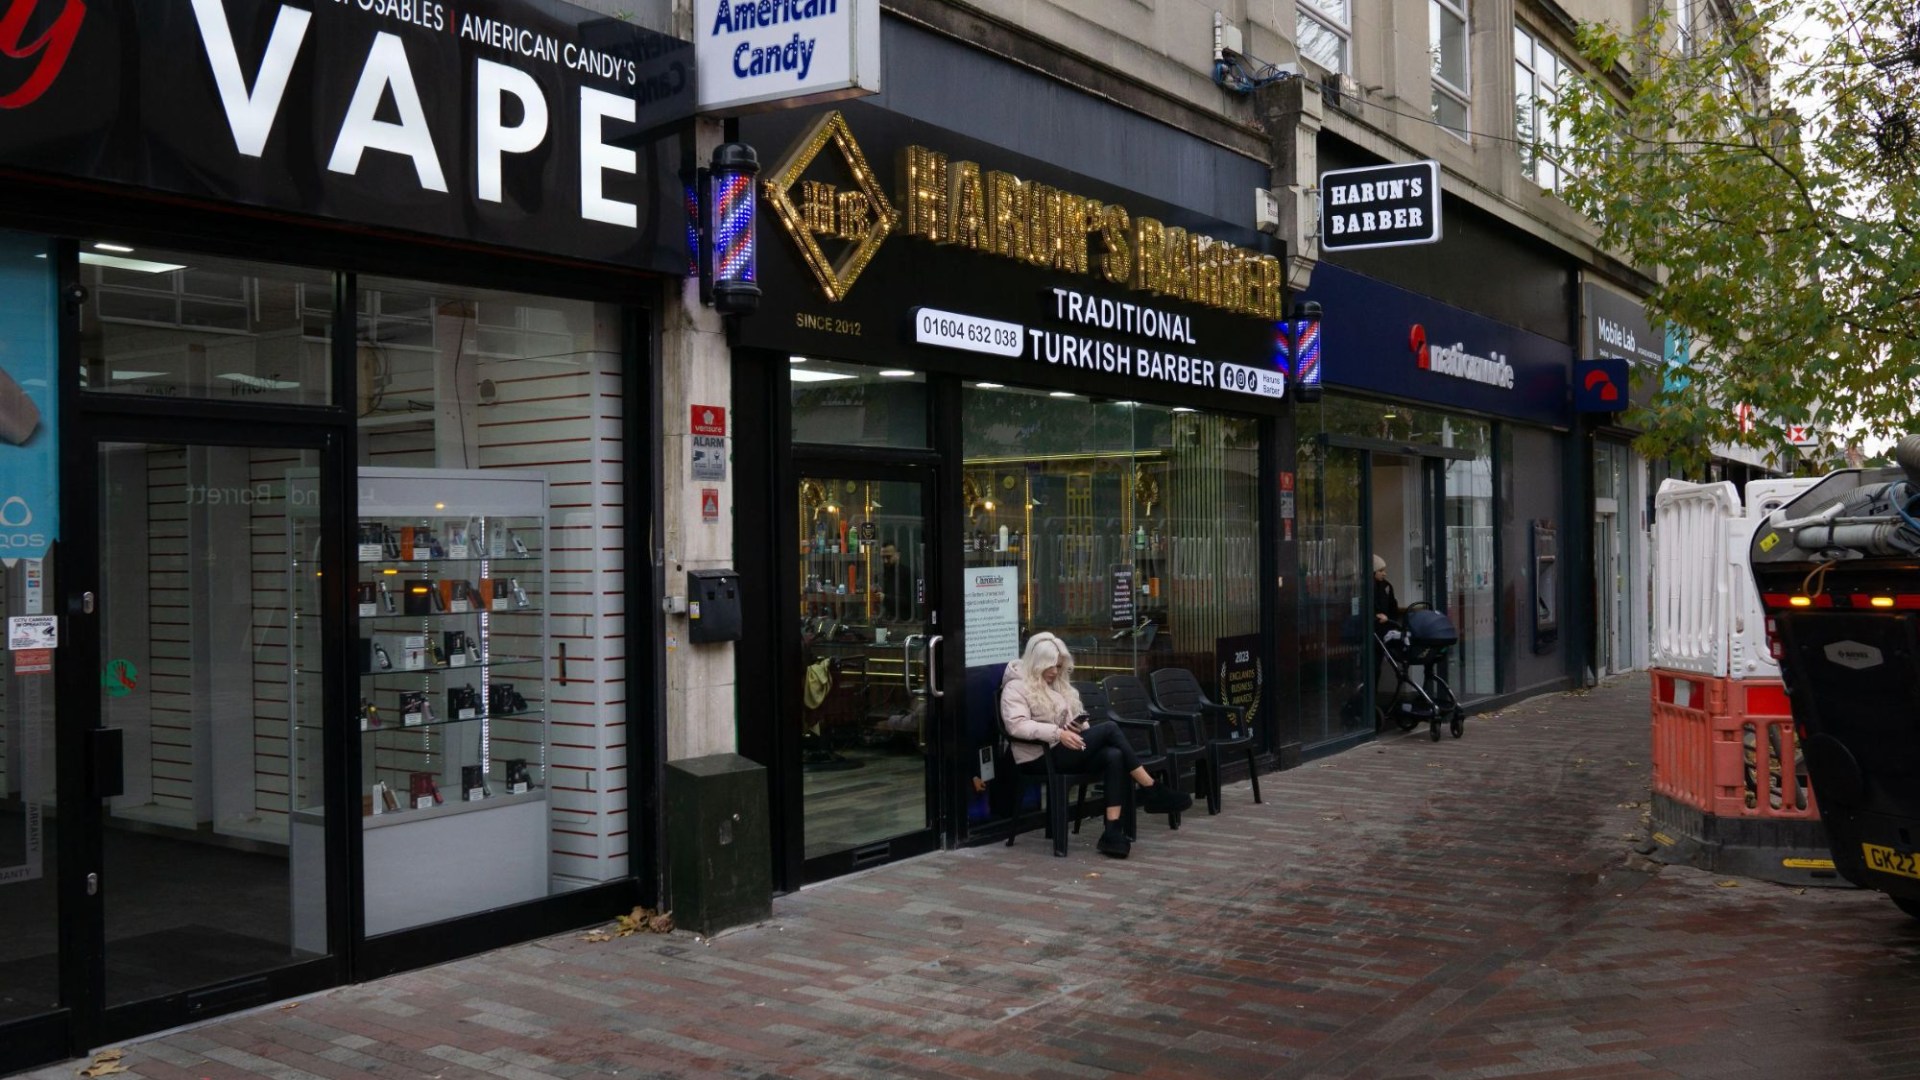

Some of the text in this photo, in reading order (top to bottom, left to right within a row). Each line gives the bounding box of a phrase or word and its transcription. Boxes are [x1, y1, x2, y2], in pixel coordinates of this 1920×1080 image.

[460, 13, 558, 63] AMERICAN
[563, 43, 636, 86] CANDY'S
[733, 33, 816, 80] Candy
[191, 0, 637, 228] VAPE
[1331, 177, 1423, 206] HARUN'S
[903, 144, 1284, 321] HARUN'S BARBER
[1331, 207, 1423, 235] BARBER
[796, 313, 862, 336] SINCE 2012
[923, 315, 1018, 348] 01604 632 038
[1053, 287, 1196, 345] TRADITIONAL
[1598, 316, 1636, 353] Mobile Lab
[1029, 329, 1215, 389] TURKISH BARBER
[1430, 342, 1515, 389] nationwide
[1262, 384, 1281, 395] Barber
[693, 436, 724, 448] ALARM
[975, 575, 1004, 585] Chronicle
[1234, 650, 1250, 664] 2023
[1870, 848, 1918, 875] GK22
